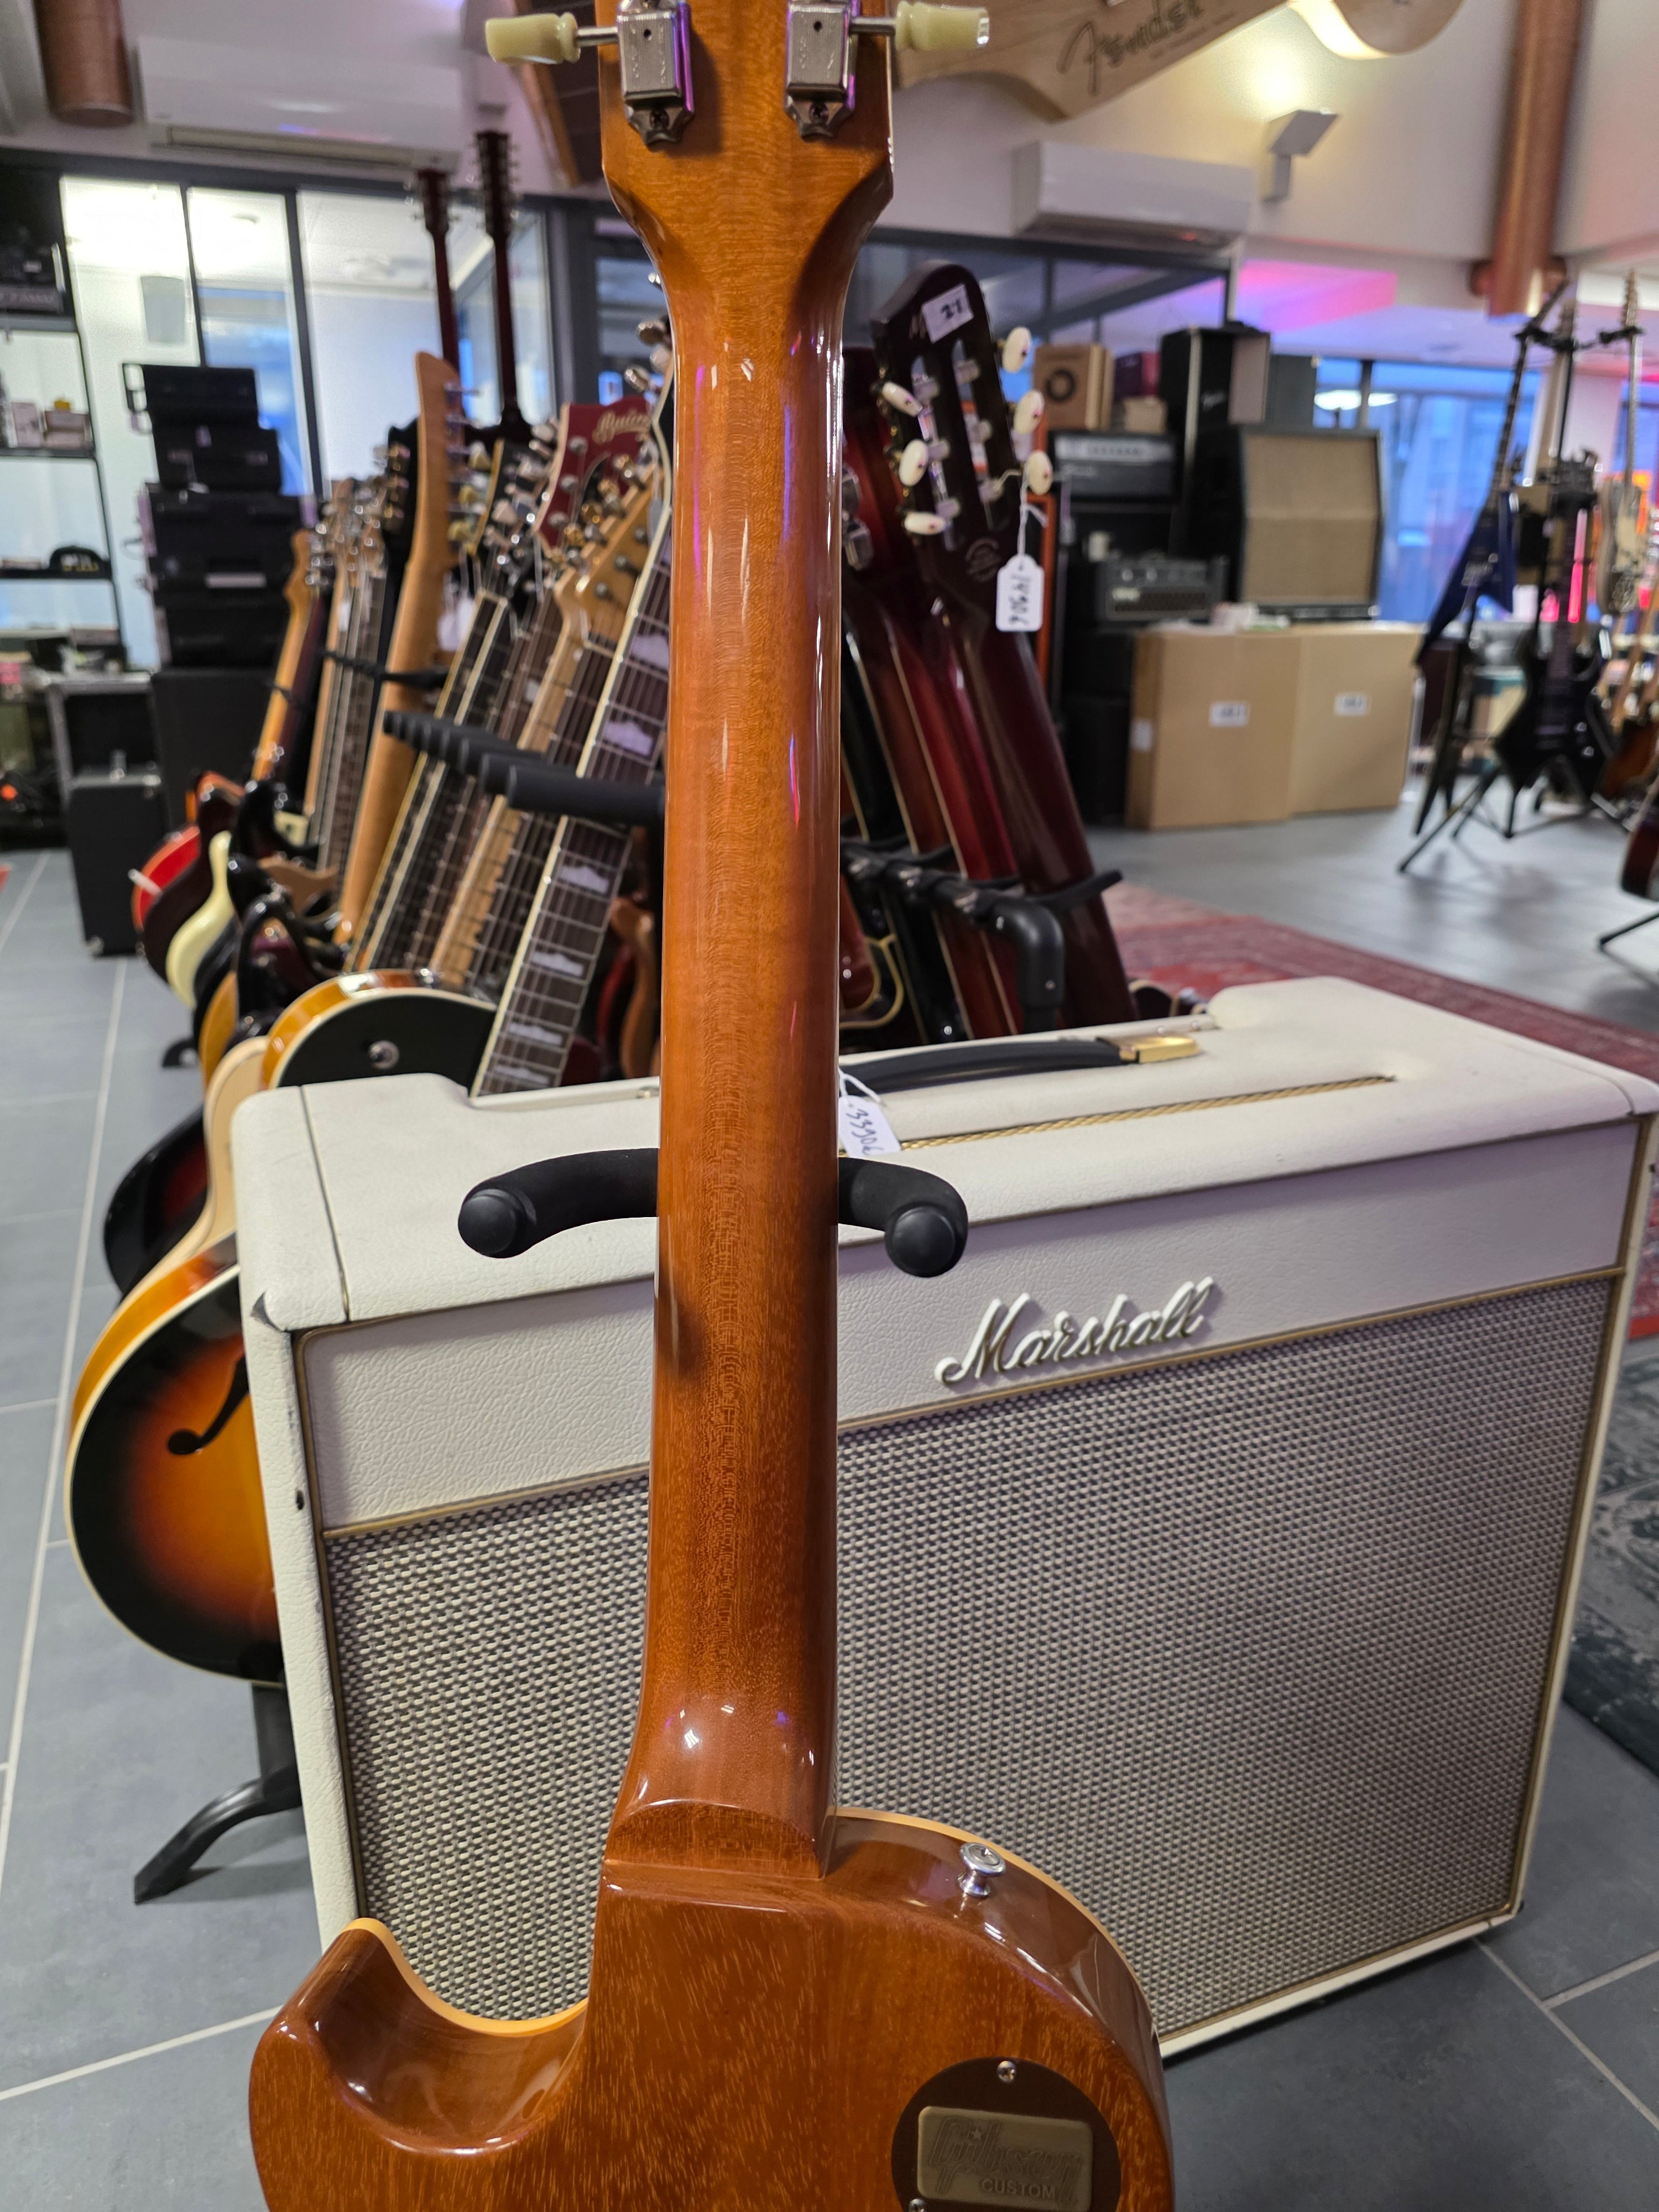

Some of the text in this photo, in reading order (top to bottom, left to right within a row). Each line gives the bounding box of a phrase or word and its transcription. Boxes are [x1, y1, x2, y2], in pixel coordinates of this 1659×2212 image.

[1056, 0, 1203, 97] Fender
[934, 1276, 1214, 1385] Marshall
[930, 2116, 1082, 2205] Gibson
[981, 2177, 1057, 2200] CUSTOM
